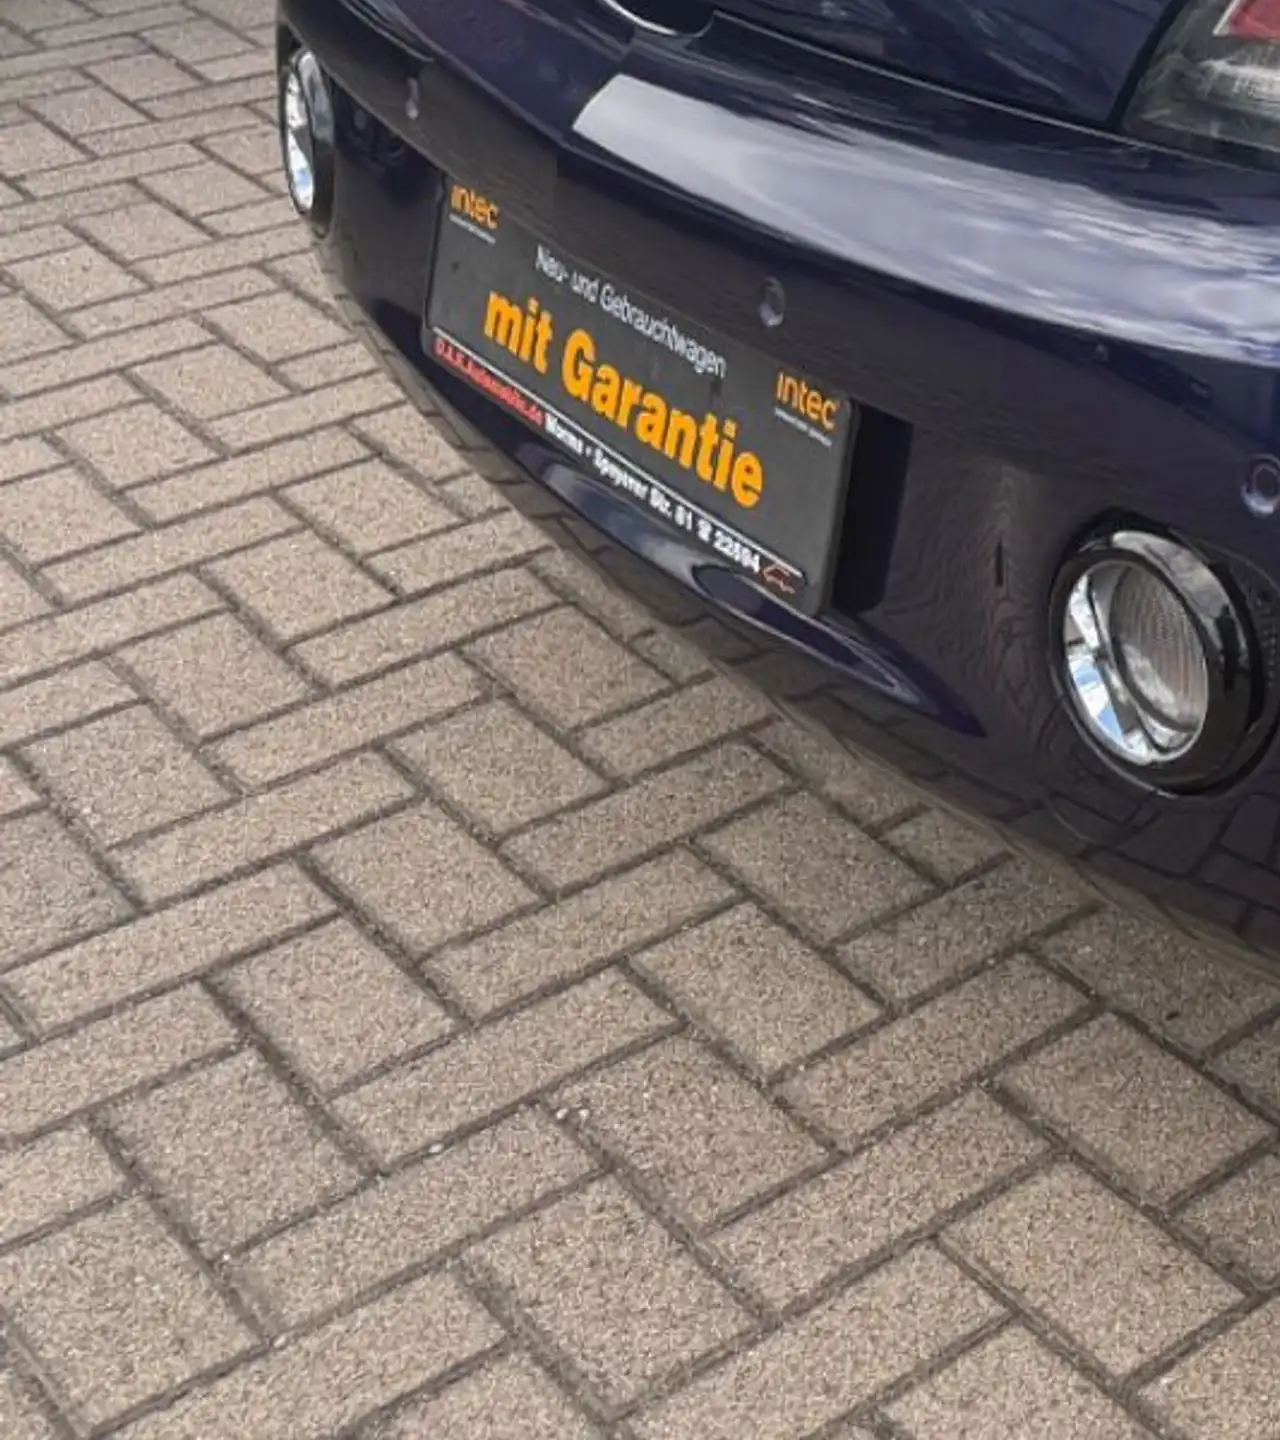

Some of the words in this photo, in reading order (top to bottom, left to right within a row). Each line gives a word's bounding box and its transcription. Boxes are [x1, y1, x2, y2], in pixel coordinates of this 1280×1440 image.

[451, 184, 500, 230] intec
[535, 244, 569, 282] Neu-
[570, 272, 599, 303] und
[600, 282, 727, 379] Gebrauchtwagen
[484, 289, 553, 375] mit
[562, 327, 764, 509] Garantie
[776, 370, 836, 431] intec
